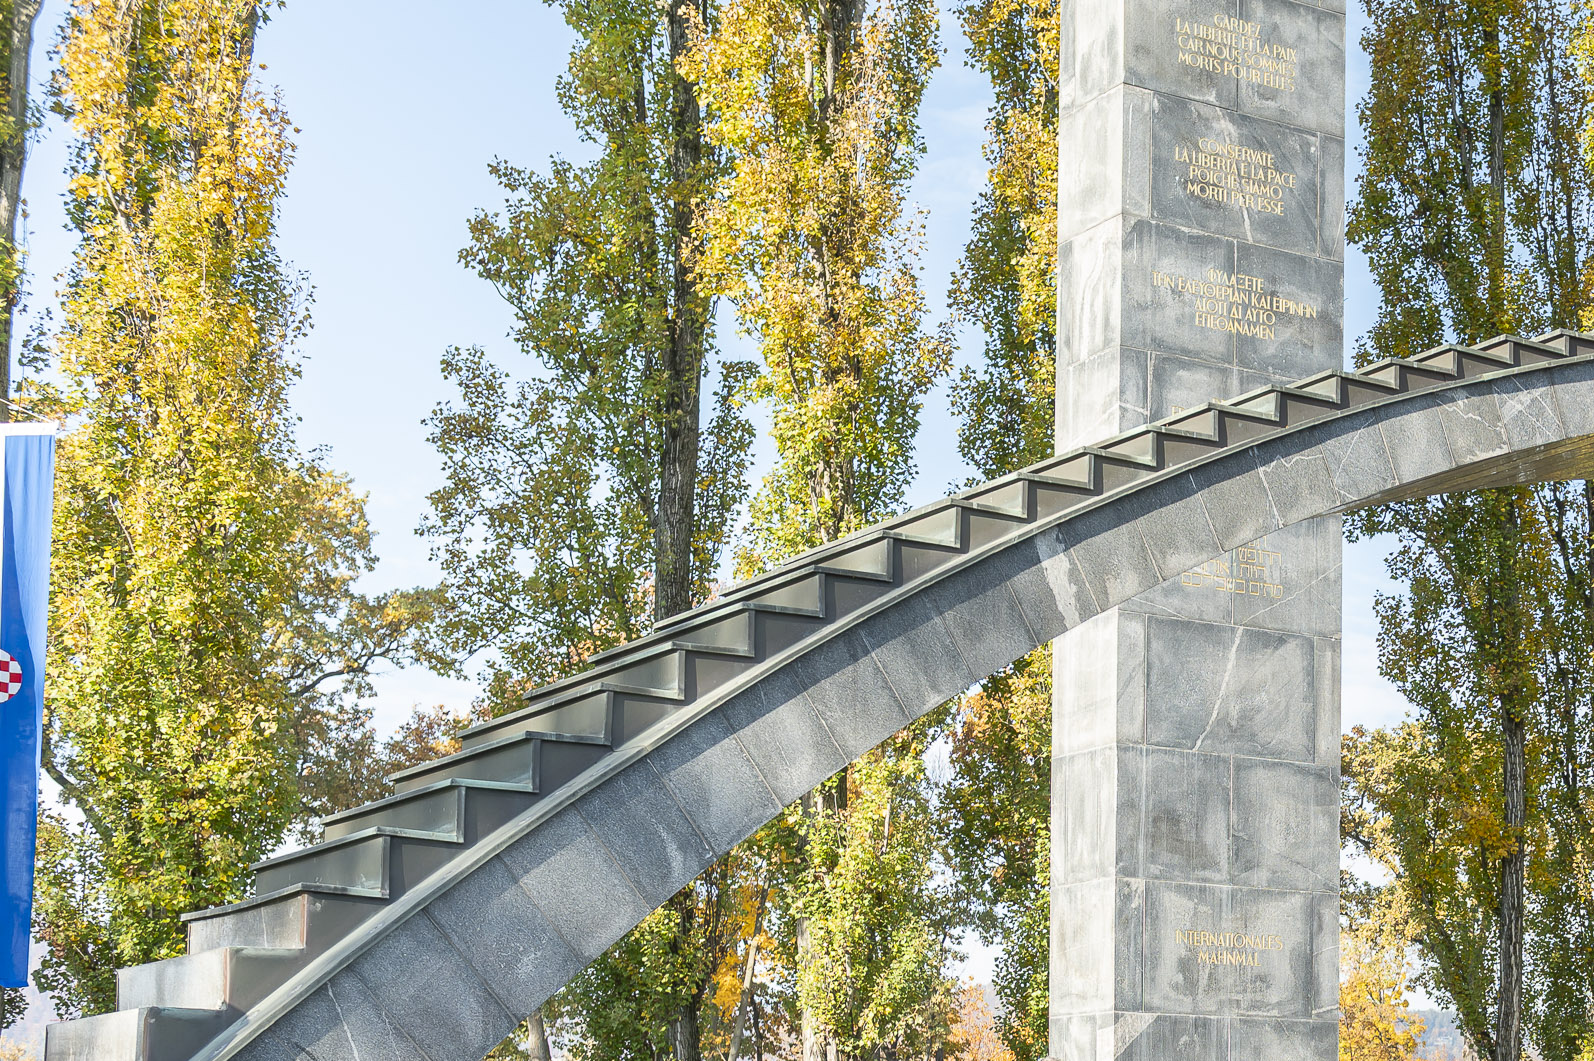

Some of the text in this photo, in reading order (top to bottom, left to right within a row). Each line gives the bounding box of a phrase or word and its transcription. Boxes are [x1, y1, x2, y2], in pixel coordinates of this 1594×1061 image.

[1176, 17, 1190, 34] LA
[1242, 36, 1253, 51] ET
[1256, 41, 1270, 56] LA
[1272, 44, 1296, 62] PAIX
[1214, 13, 1261, 38] GARDEZ
[1178, 35, 1295, 77] CAR NOUS SOMMES
[1178, 50, 1294, 92] MORTS POUR ELLES
[1175, 146, 1189, 163] LA
[1240, 162, 1248, 177] E
[1251, 164, 1265, 181] LA
[1267, 169, 1296, 188] PACE
[1199, 137, 1274, 168] CONSERVATE
[1187, 181, 1284, 216] MORTI PER ESSE
[1242, 178, 1282, 199] SIAMO
[1152, 271, 1175, 288] ΤΗΝ
[1178, 277, 1249, 304] ΕΛΕΥΘΕΡΙΑΝ
[1251, 292, 1271, 310] ΚΑΙ
[1207, 267, 1264, 293] ΦΥΛΑΞΕΤΕ
[1195, 297, 1227, 316] ΔΙΟΤΙ
[1245, 307, 1275, 325] ΑΥΤΟ
[1175, 929, 1283, 950] INTERNATIONALES
[1198, 950, 1261, 967] MAHNMAL
